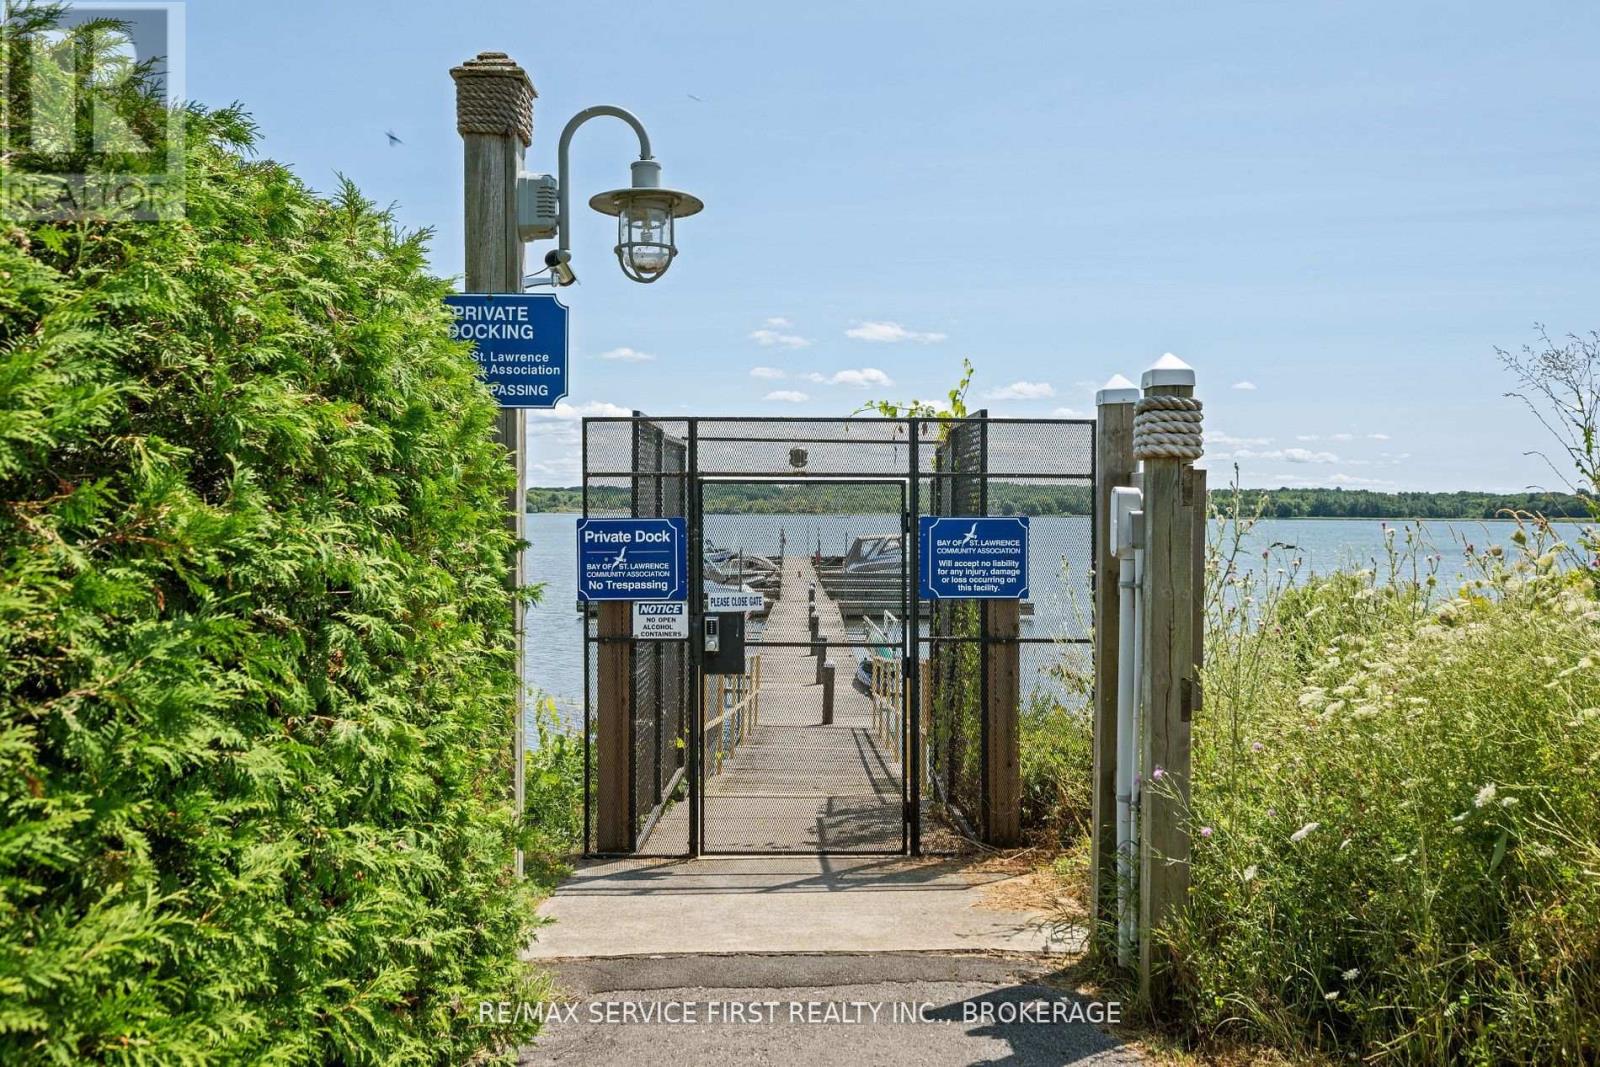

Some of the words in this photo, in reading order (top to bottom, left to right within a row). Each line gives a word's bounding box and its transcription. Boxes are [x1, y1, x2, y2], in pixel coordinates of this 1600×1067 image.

[453, 306, 528, 321] PRIVATE
[447, 324, 534, 339] DOCKING
[472, 352, 487, 362] St.
[490, 352, 549, 362] Lawrence
[490, 364, 560, 375] Association
[490, 384, 549, 396] PASSING
[585, 531, 631, 543] Private
[635, 530, 671, 543] Dock
[937, 539, 951, 547] BAY
[952, 539, 962, 547] OF
[969, 539, 980, 547] ST.
[980, 539, 1020, 547] LAWRENCE
[937, 547, 976, 555] COMMUNITY
[977, 547, 1020, 555] ASSOCIATION
[954, 560, 980, 569] accept
[992, 560, 1020, 569] liability
[937, 568, 949, 576] for
[950, 569, 964, 578] any
[965, 568, 989, 577] injury,
[990, 568, 1020, 578] damage
[589, 581, 603, 590] No
[606, 580, 668, 592] Trespassing
[968, 576, 1005, 586] occurring
[957, 584, 972, 592] this
[973, 584, 1001, 593] facility.
[710, 597, 730, 608] PLEASE
[732, 597, 748, 607] CLOSE
[749, 596, 763, 606] GATE
[640, 604, 681, 614] NOTICE
